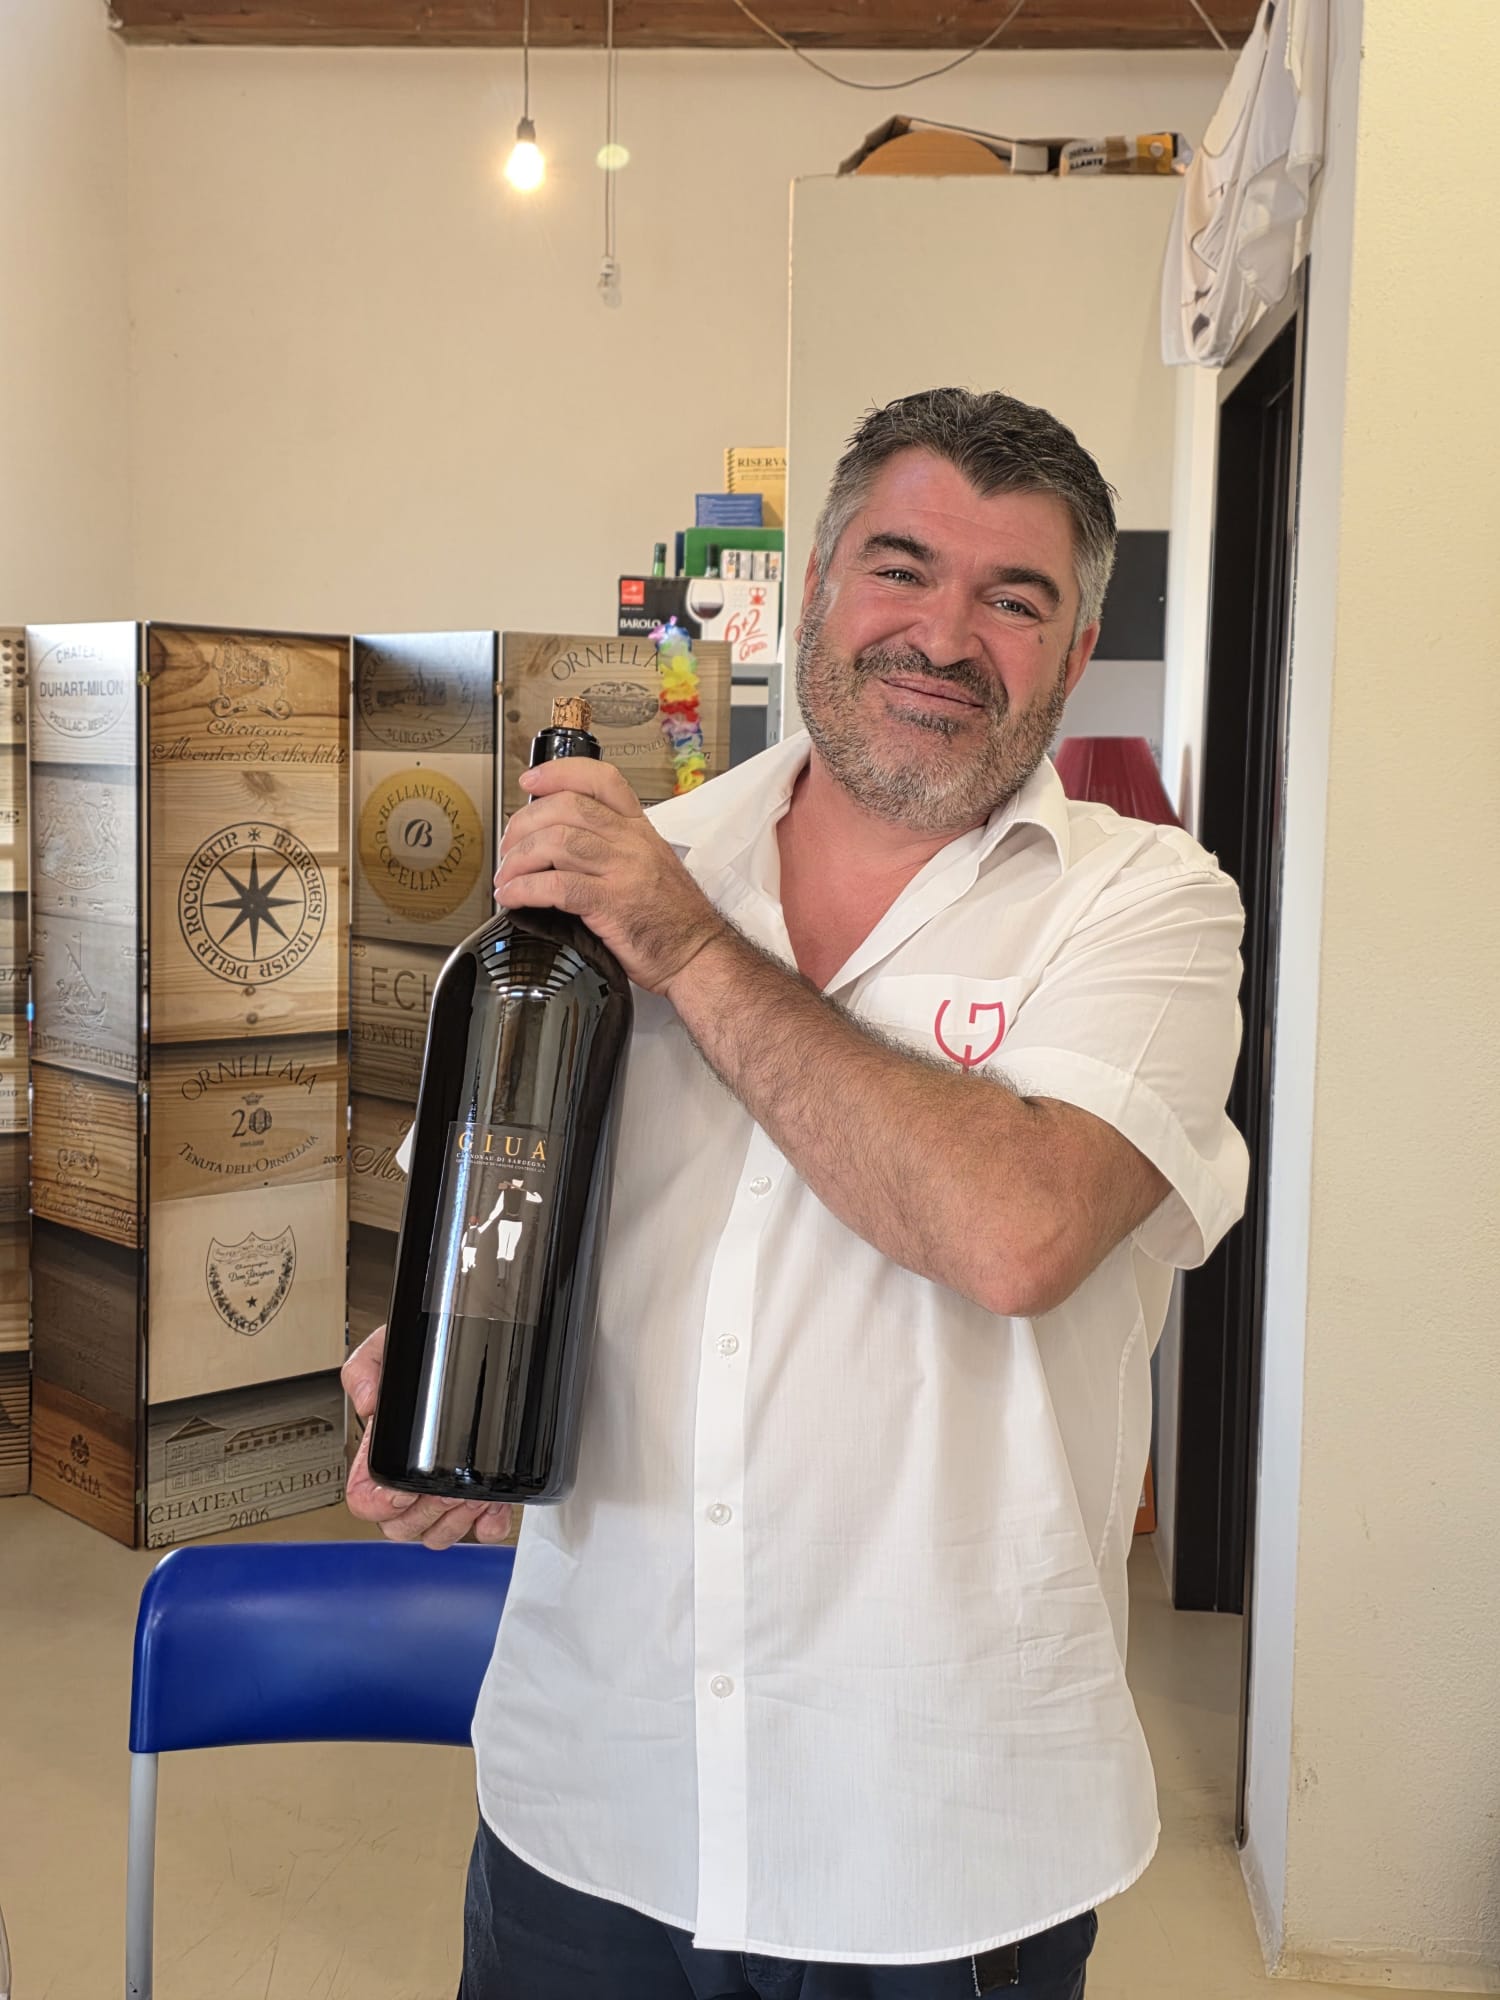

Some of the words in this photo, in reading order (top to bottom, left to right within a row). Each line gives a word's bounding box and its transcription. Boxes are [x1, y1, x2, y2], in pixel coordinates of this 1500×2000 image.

[620, 618, 661, 629] BAROLO
[551, 643, 664, 680] ORNELLA
[40, 680, 124, 697] DUHART-MILON
[378, 784, 460, 823] BELLAVISTA
[181, 1054, 317, 1101] ORNELLAIA
[57, 1459, 101, 1499] SOLAIA
[150, 1487, 250, 1525] CHATEAU
[261, 1465, 345, 1498] TALBOT
[228, 1507, 270, 1530] 2006
